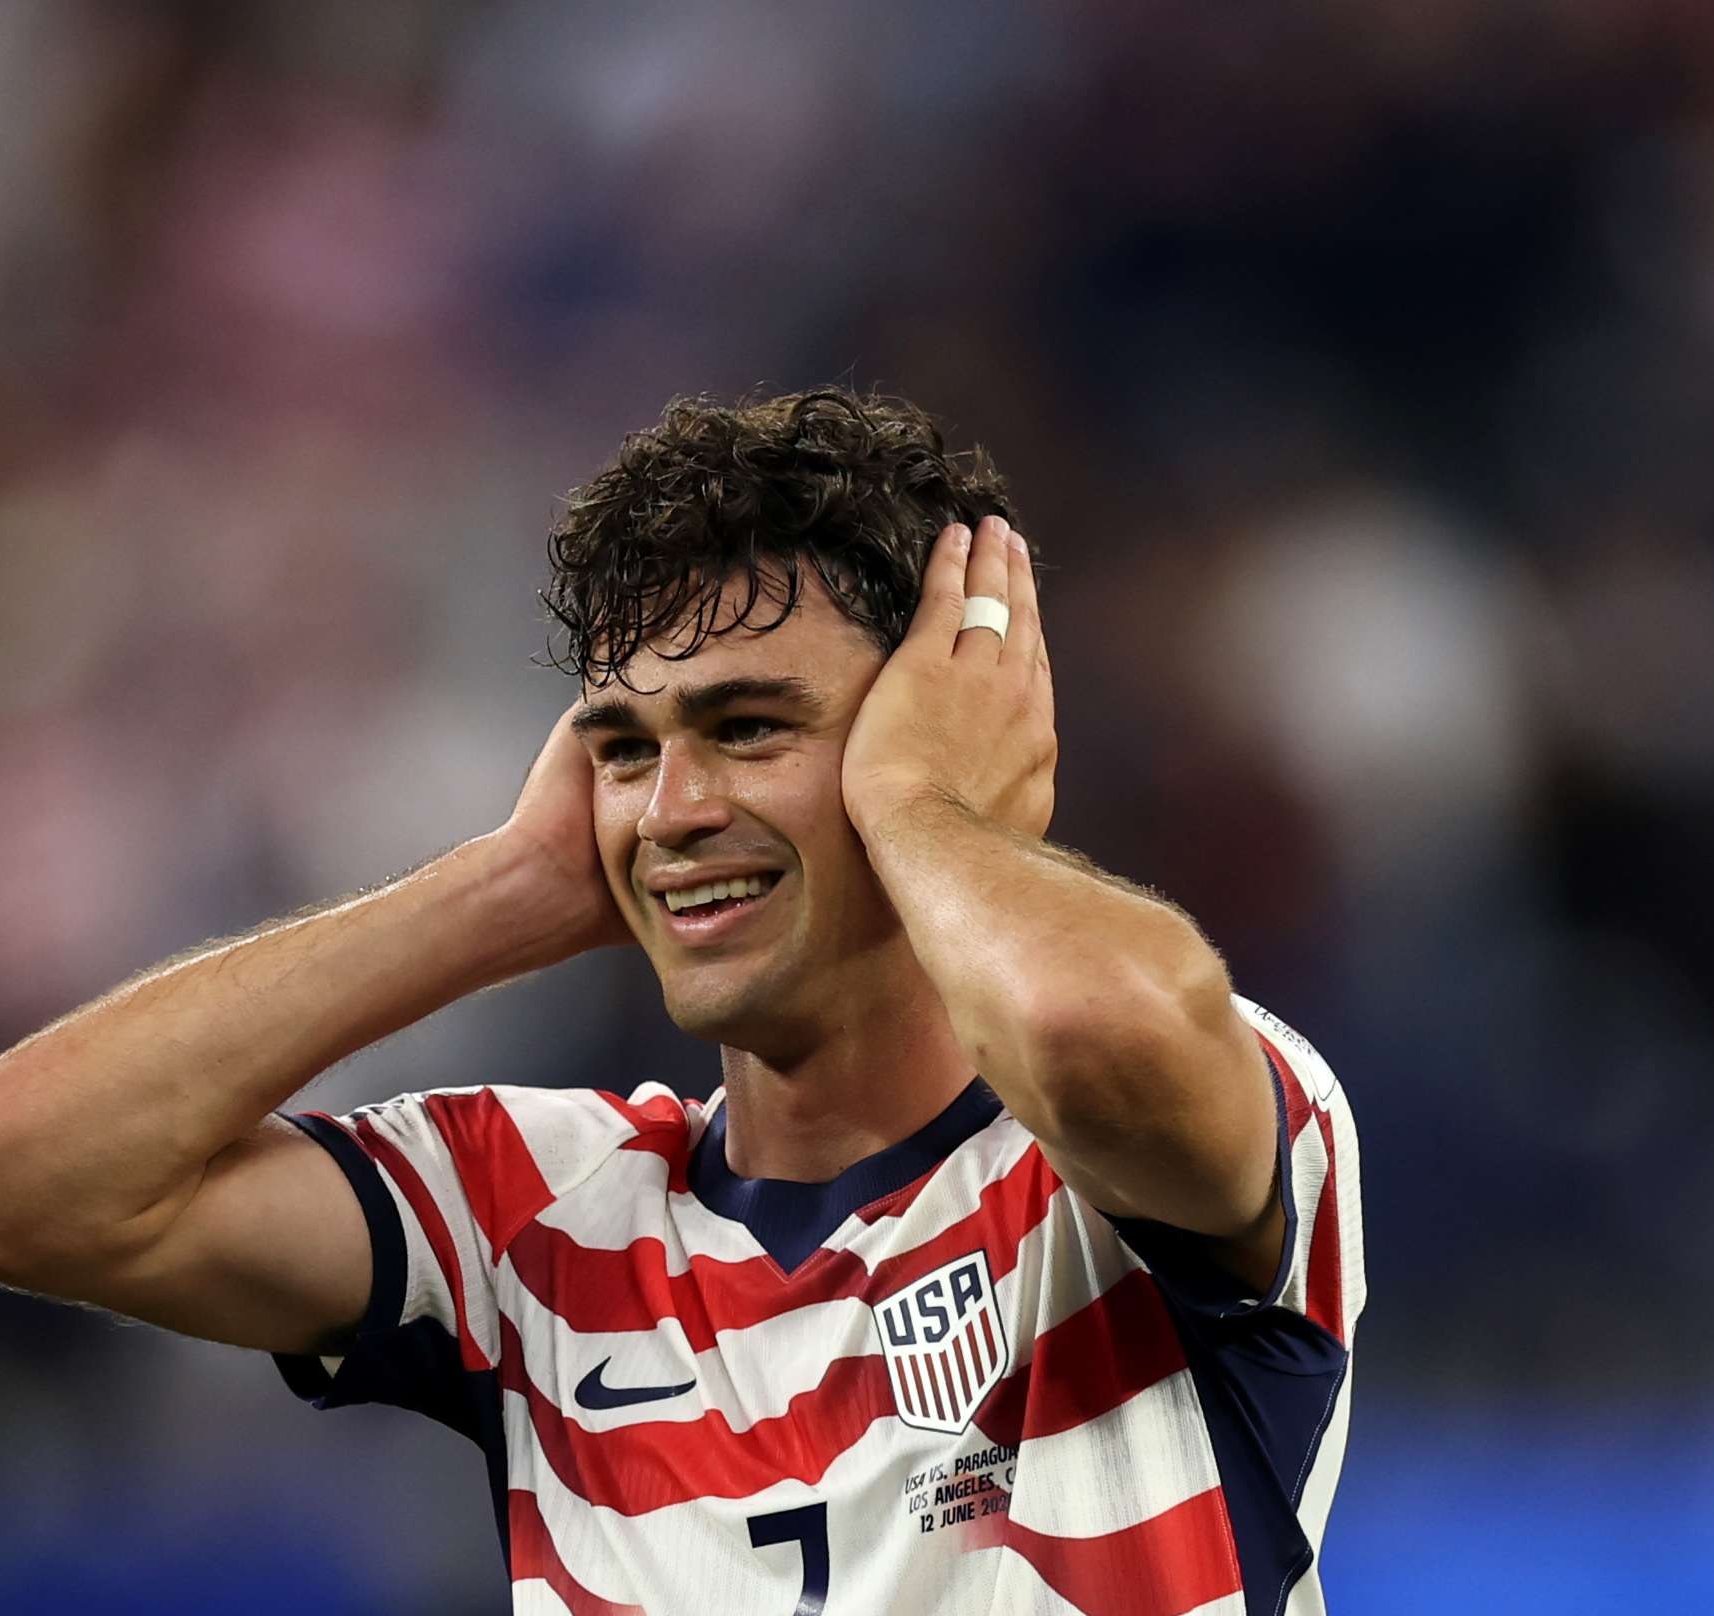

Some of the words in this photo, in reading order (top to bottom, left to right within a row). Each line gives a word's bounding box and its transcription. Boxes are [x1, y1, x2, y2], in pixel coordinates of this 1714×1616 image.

[883, 1262, 983, 1346] USA
[905, 1472, 926, 1494] USA
[929, 1463, 947, 1482] VS.
[955, 1444, 1019, 1476] PARAGUA
[909, 1491, 928, 1514] LOS
[1005, 1467, 1017, 1485] C
[920, 1514, 934, 1533] 12
[940, 1502, 975, 1528] JUNE
[981, 1492, 1012, 1516] 202
